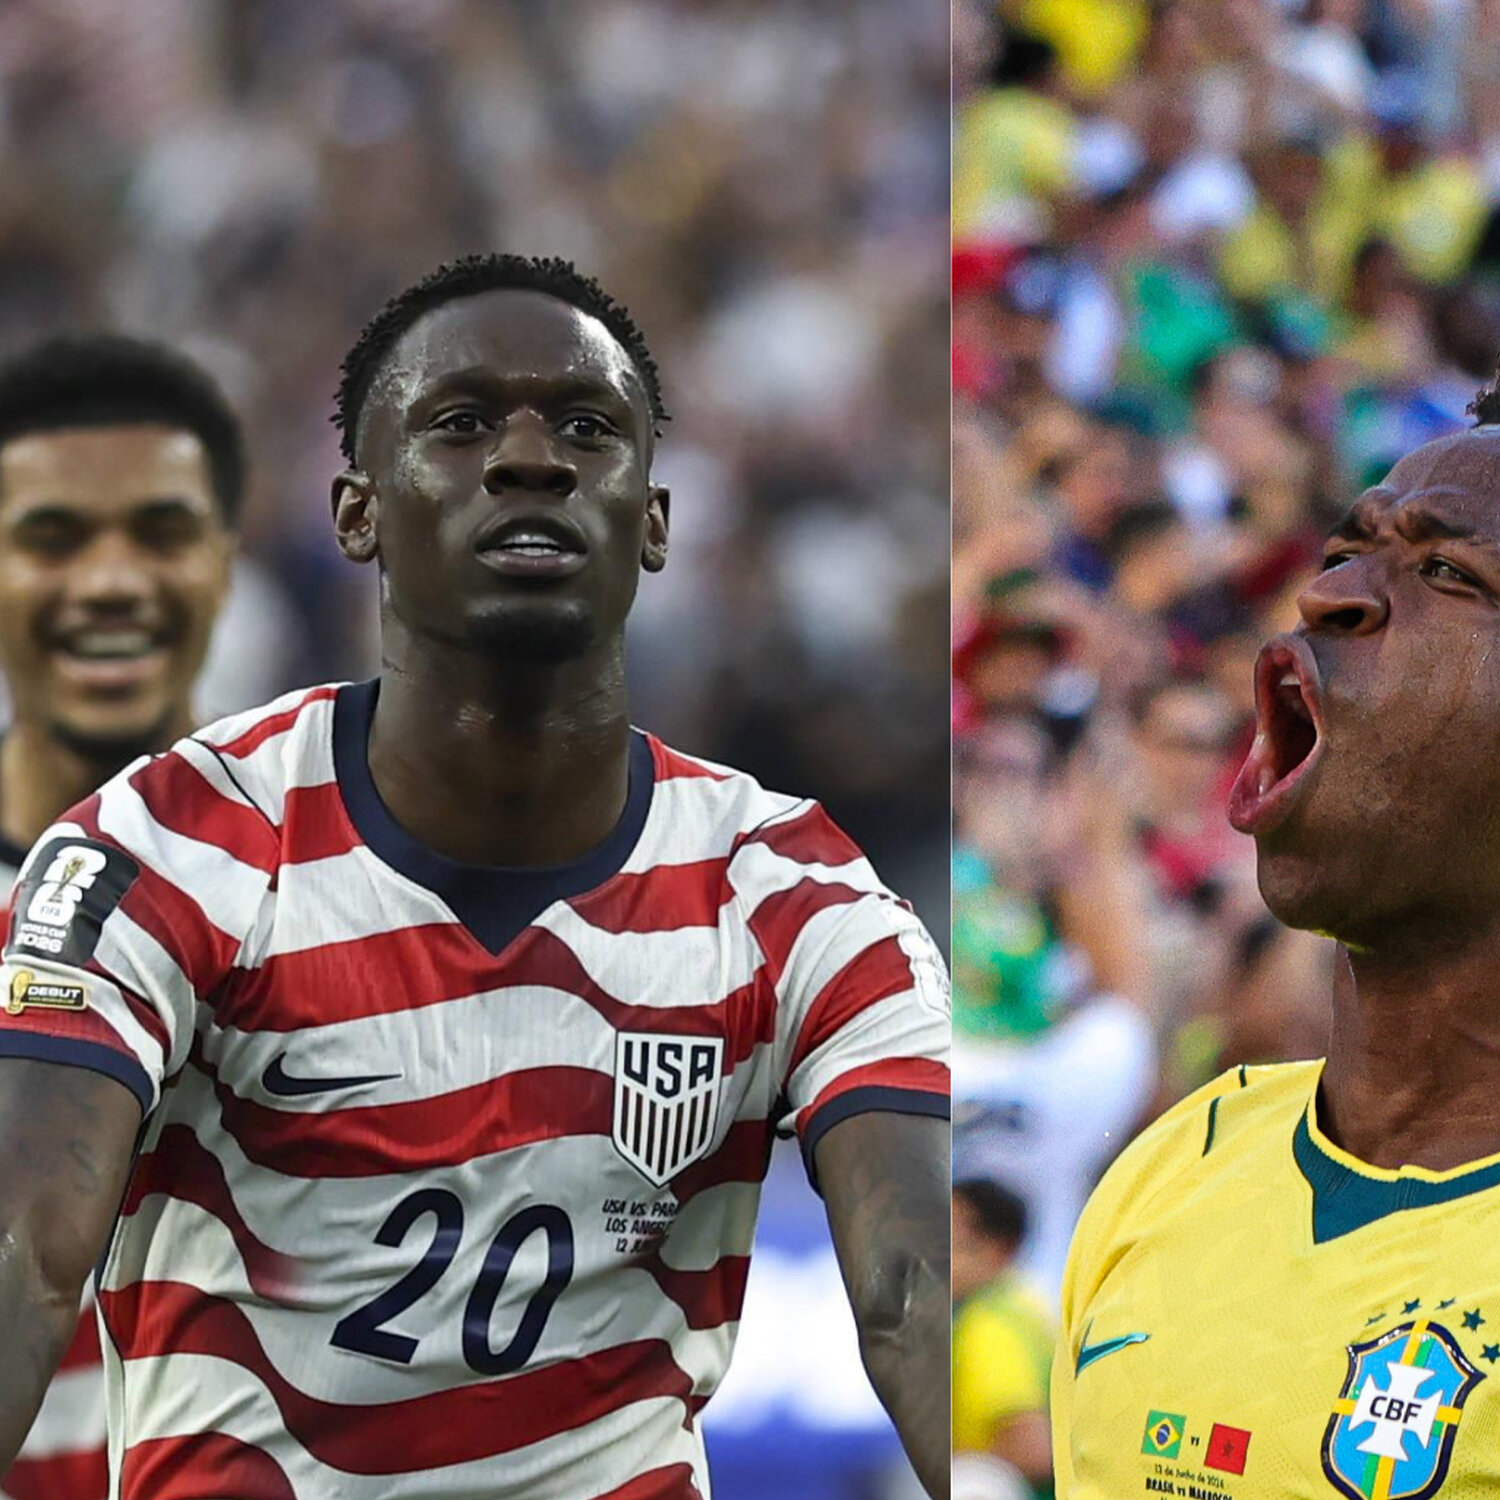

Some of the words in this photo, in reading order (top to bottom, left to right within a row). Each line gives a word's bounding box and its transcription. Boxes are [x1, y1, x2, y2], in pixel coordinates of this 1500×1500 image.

[27, 986, 81, 999] DEBUT
[623, 1040, 716, 1099] USA
[602, 1199, 626, 1214] USA
[605, 1217, 628, 1234] LOS
[329, 1187, 575, 1376] 20
[1369, 1395, 1422, 1424] CBF
[1145, 1476, 1175, 1495] BRASIL
